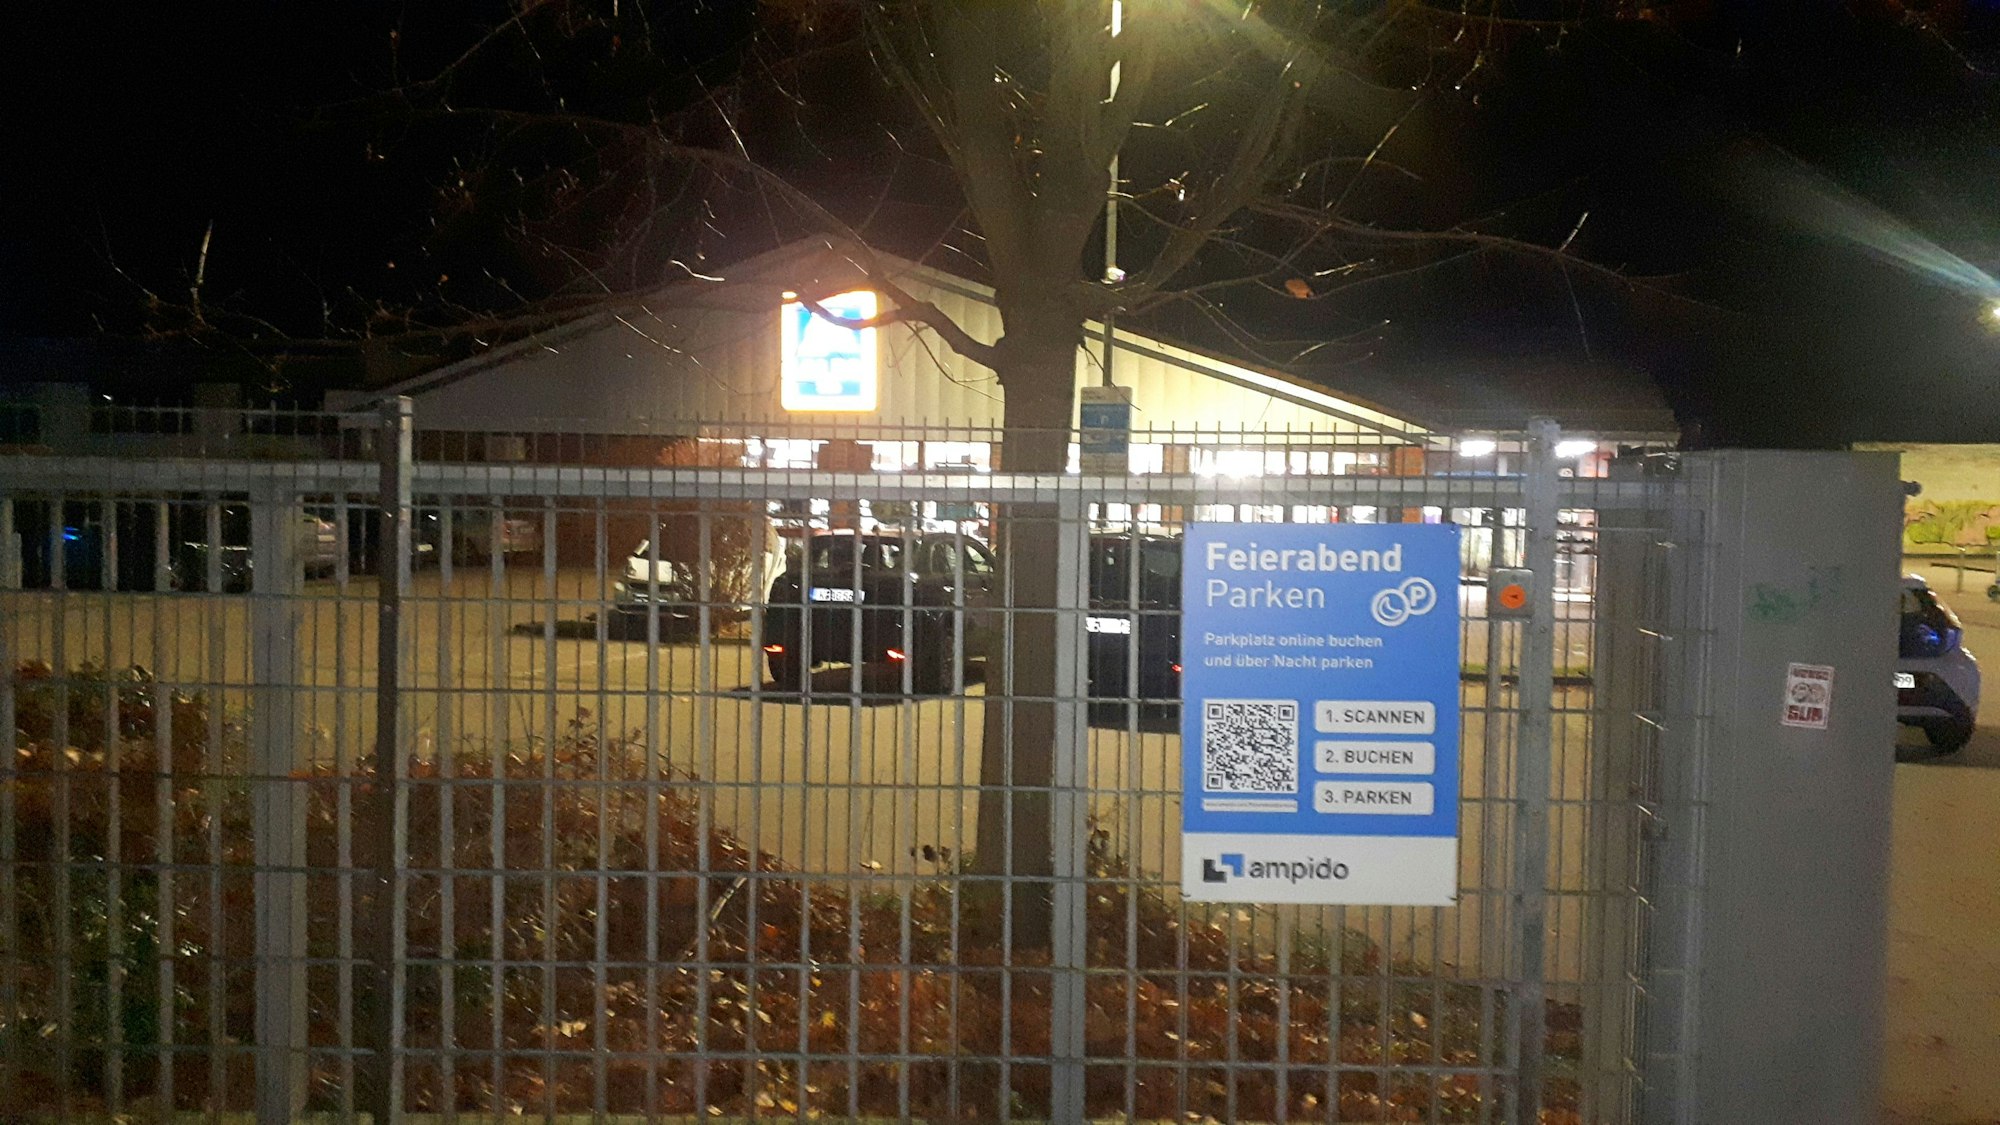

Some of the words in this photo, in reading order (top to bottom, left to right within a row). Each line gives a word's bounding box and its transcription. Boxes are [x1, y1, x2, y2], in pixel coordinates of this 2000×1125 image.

[1205, 542, 1403, 572] Feierabend
[1206, 579, 1326, 609] Parken
[1410, 586, 1427, 606] P
[1204, 632, 1276, 649] Parkplatz
[1279, 634, 1325, 647] online
[1329, 635, 1383, 648] buchen
[1204, 655, 1232, 667] und
[1236, 654, 1269, 668] über
[1274, 655, 1317, 668] Nacht
[1321, 656, 1373, 670] parken
[1325, 709, 1339, 723] 1.
[1343, 709, 1425, 725] SCANNEN
[1325, 750, 1339, 764] 2.
[1344, 750, 1414, 765] BUCHEN
[1324, 790, 1339, 805] 3.
[1343, 790, 1412, 805] PARKEN
[1249, 857, 1350, 884] ampido
